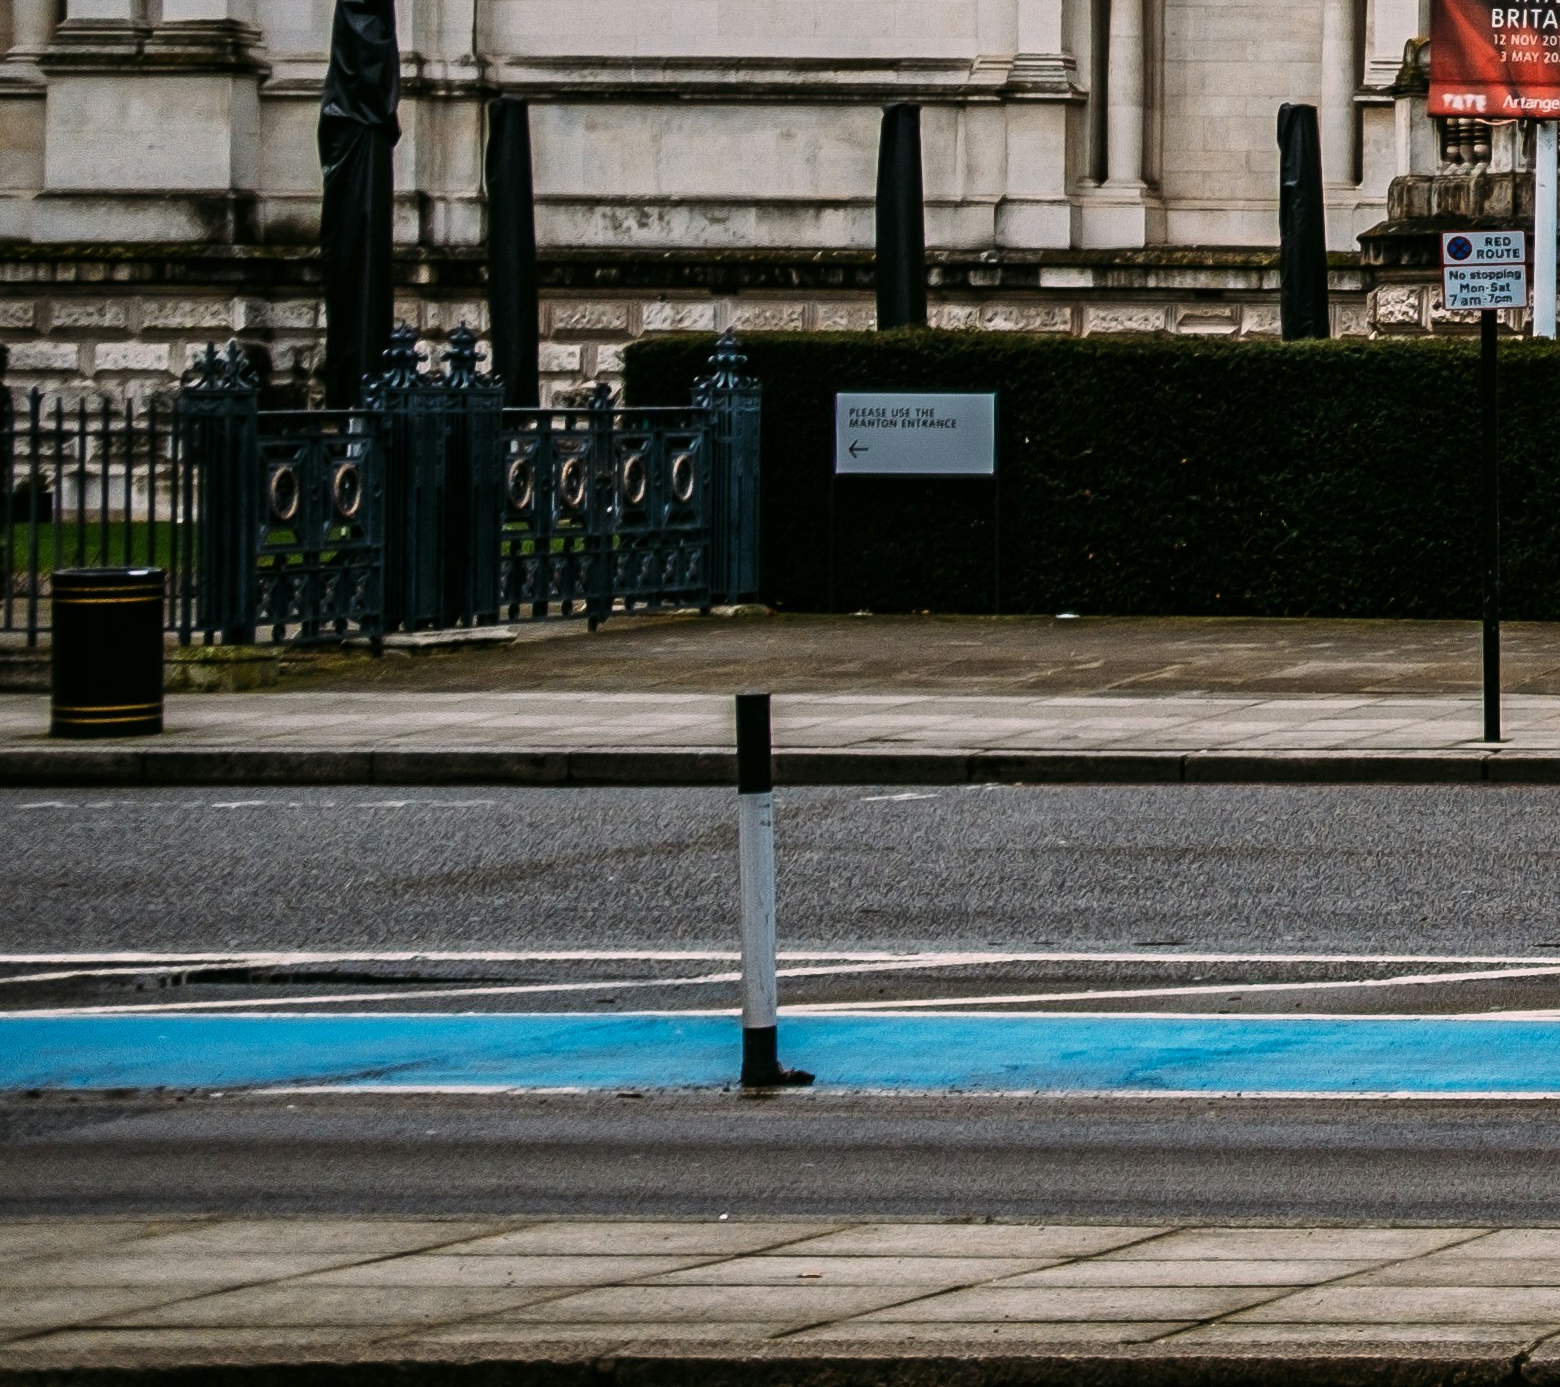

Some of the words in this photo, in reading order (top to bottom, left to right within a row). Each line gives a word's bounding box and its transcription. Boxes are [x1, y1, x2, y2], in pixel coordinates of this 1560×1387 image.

[1494, 34, 1506, 46] 12
[1510, 34, 1538, 47] NOV
[1500, 52, 1507, 63] 3
[1511, 52, 1540, 64] MAY
[1441, 94, 1487, 111] TATE
[1484, 236, 1512, 247] RED
[1476, 248, 1521, 259] ROUTE
[1449, 270, 1466, 281] No
[1469, 268, 1522, 281] stopping
[849, 407, 886, 418] PLEASE
[891, 407, 910, 418] USE
[915, 408, 934, 418] THE
[849, 418, 897, 428] MANTON
[902, 418, 956, 428] ENTRANCE
